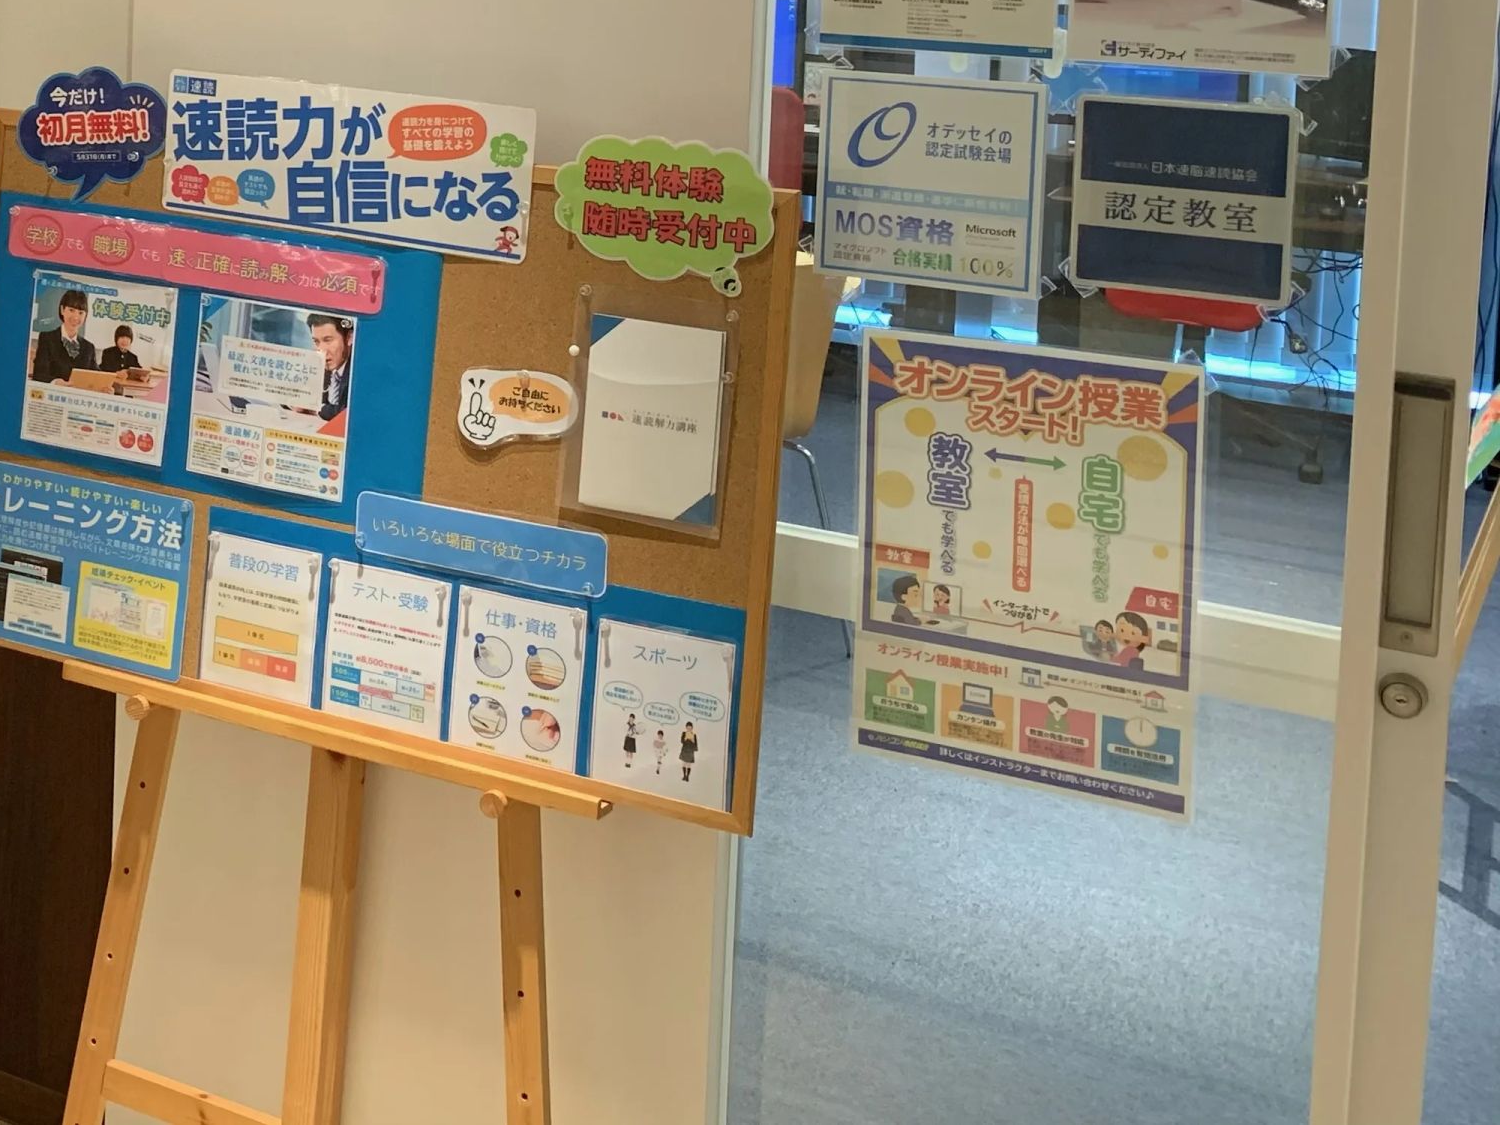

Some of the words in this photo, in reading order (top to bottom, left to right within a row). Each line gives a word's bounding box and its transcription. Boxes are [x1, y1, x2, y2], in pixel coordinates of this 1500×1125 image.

[1118, 46, 1187, 61] サーティファイ
[49, 86, 105, 108] 今だけ!
[190, 79, 216, 95] 速読
[37, 109, 150, 146] 初月無料!
[172, 95, 387, 163] 速読力が
[401, 127, 475, 140] すべての学習の
[926, 122, 1013, 145] オデッセイの
[925, 141, 1013, 165] 認定試験会場
[286, 159, 522, 225] 自信になる
[584, 156, 725, 203] 無料体験
[581, 200, 757, 254] 随時受付中
[835, 209, 955, 246] MOS資格
[965, 224, 1017, 238] Microsoft
[1103, 190, 1259, 234] 認定教室
[893, 249, 953, 273] 合格実績
[959, 257, 1014, 279] 100%
[91, 298, 172, 329] 体験受付中
[512, 386, 549, 401] ご自由に
[896, 359, 1166, 427] オンライン授業
[968, 404, 1082, 443] スタート!
[3, 473, 163, 515] わかりやすい・続けやすい・楽しい
[372, 517, 588, 572] いろいろな場面で役立つチカラ
[885, 547, 913, 565] 教室
[228, 552, 300, 583] 普段の学習
[351, 581, 429, 613] テスト・受験
[991, 597, 1051, 617] インターネットで
[1144, 594, 1173, 611] 自宅
[485, 608, 558, 640] 仕事・資格
[632, 644, 699, 671] スポーツ
[876, 642, 1010, 679] オンライン授業実施中!
